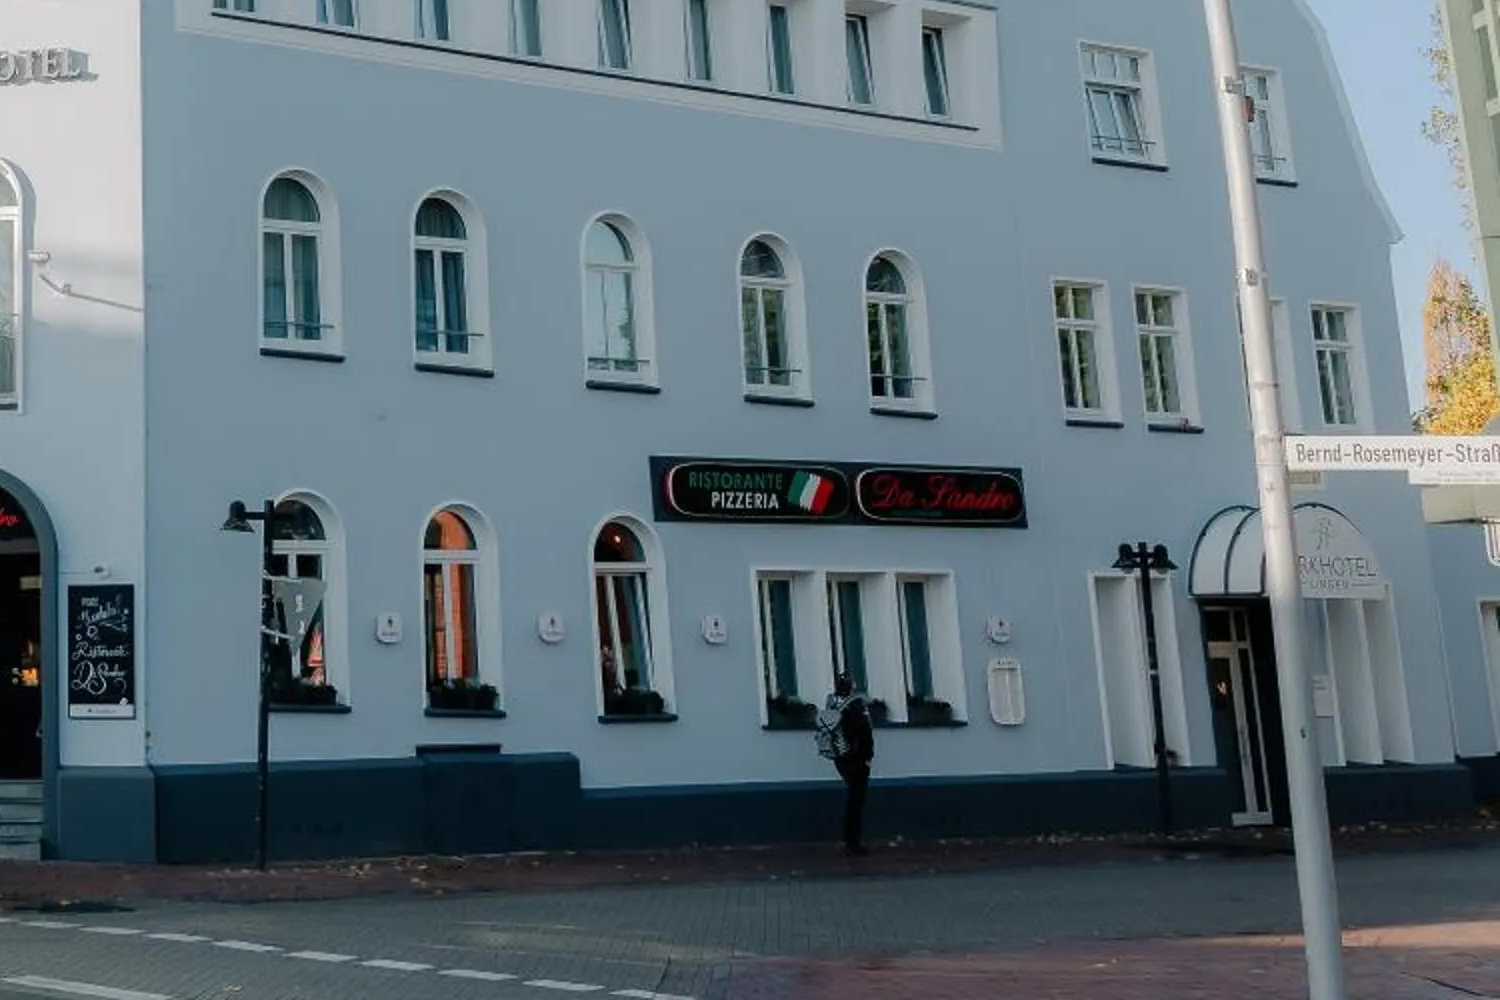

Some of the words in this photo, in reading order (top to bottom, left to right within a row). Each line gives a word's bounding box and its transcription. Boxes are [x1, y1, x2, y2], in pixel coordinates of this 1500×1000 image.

[688, 471, 784, 491] RISTORANTE
[710, 491, 779, 510] PIZZERIA
[872, 475, 915, 509] Da
[1298, 555, 1377, 577] RKHOTEL
